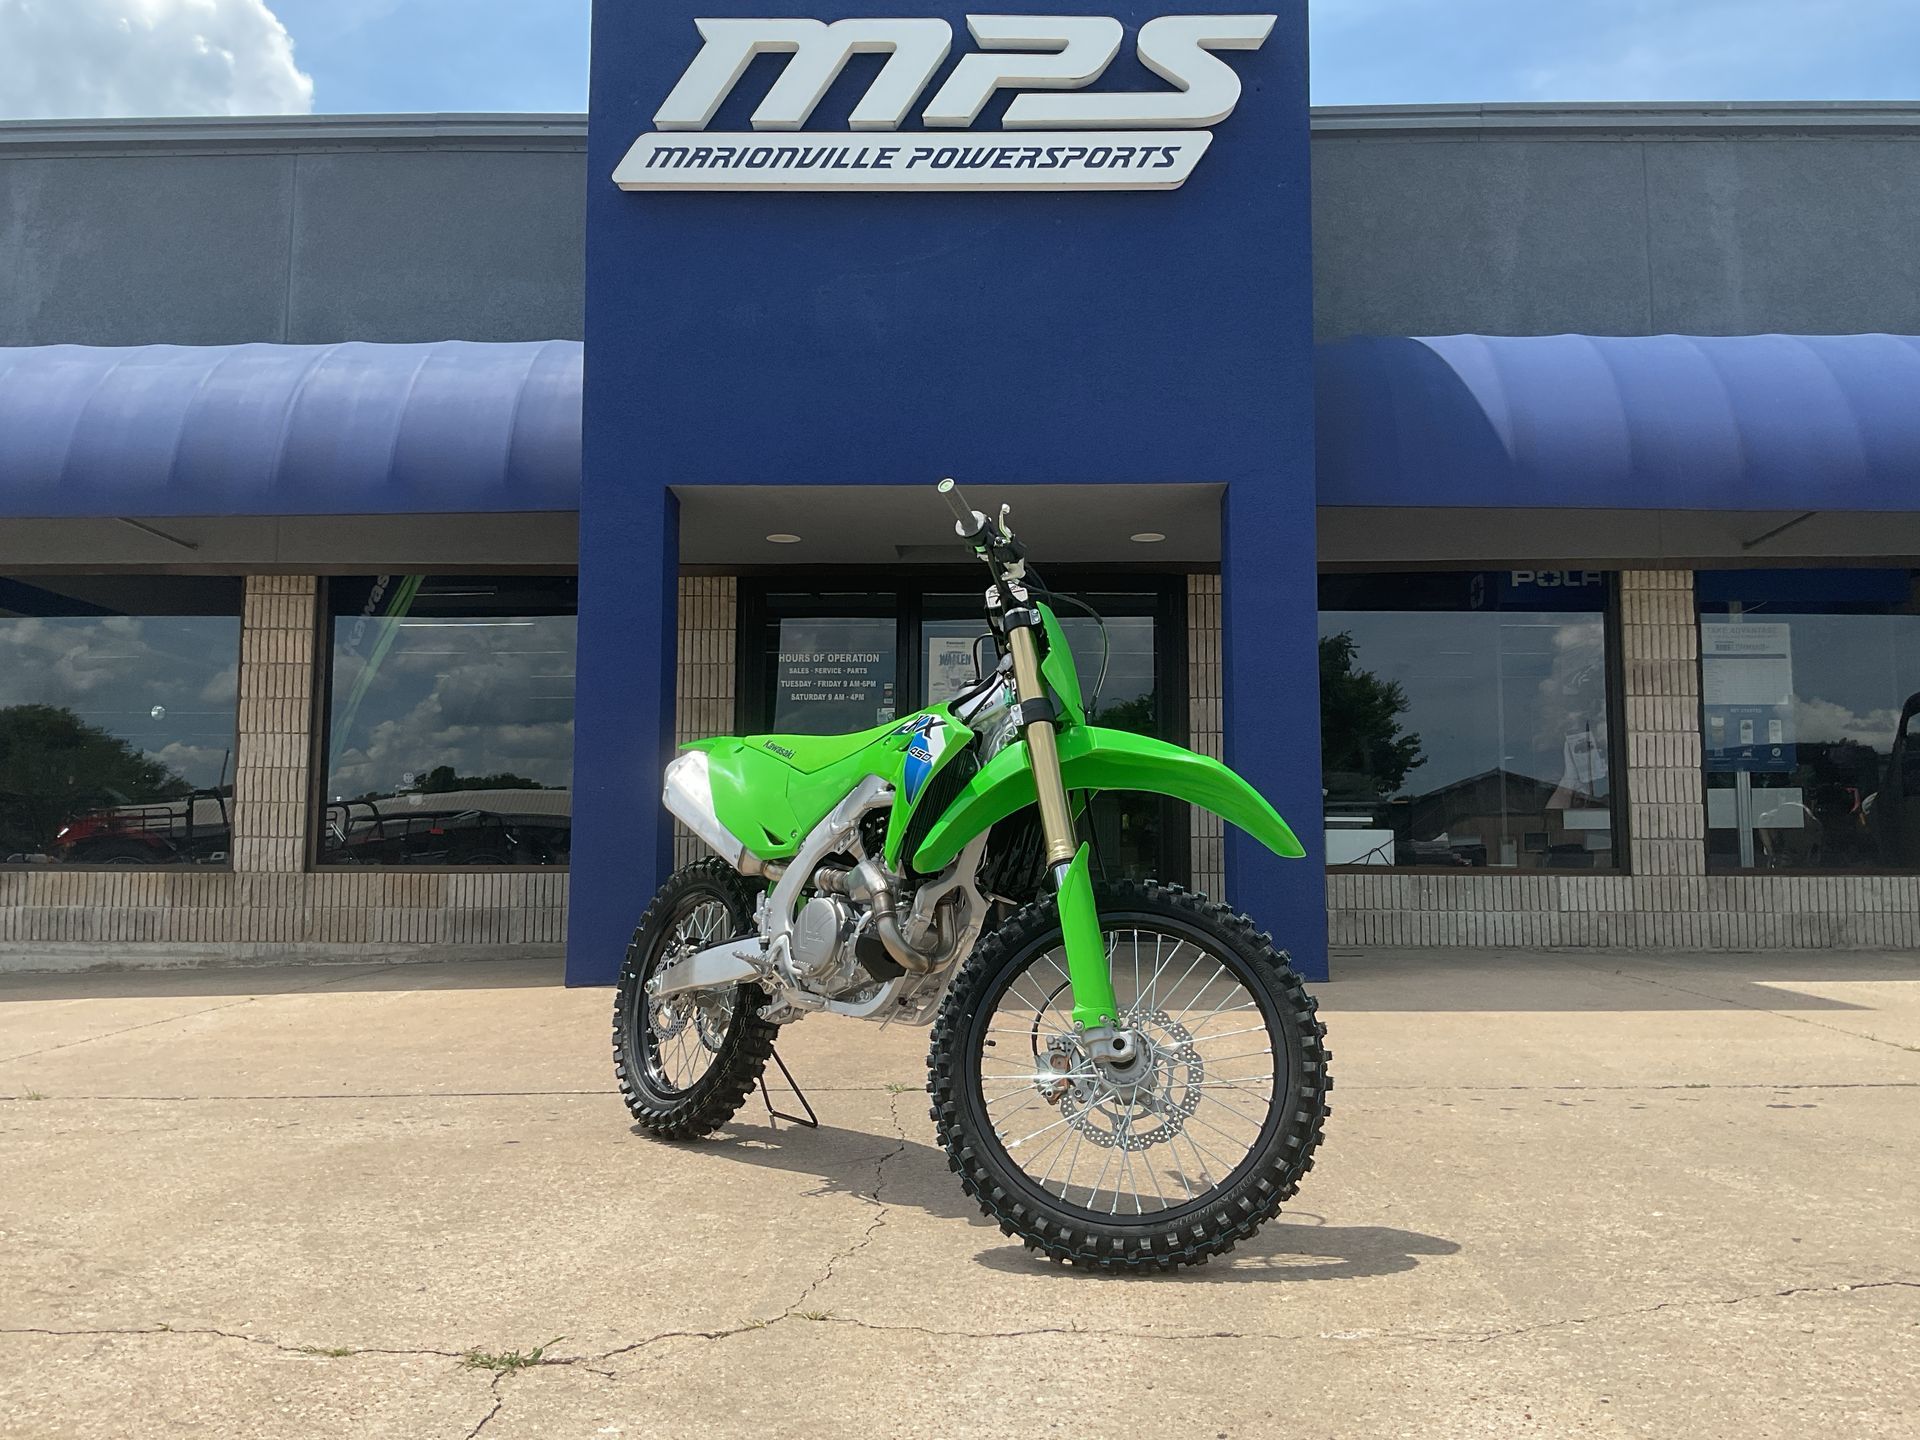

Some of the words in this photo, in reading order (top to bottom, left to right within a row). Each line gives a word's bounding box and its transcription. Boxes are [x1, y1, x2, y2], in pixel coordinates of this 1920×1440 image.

[653, 14, 1277, 130] MPS
[645, 147, 901, 169] MARIONVILLE
[905, 146, 1182, 169] POWERSPORTS
[778, 653, 810, 663] HOURS
[813, 653, 825, 663] OF
[828, 653, 880, 663] OPERATION
[780, 680, 812, 688] TUESDAY
[817, 680, 842, 688] FRIDAY
[843, 680, 848, 688] 9
[791, 693, 827, 701] SATURDAY
[827, 693, 832, 701] 9
[833, 693, 845, 701] AM
[850, 693, 865, 701] 4PM
[903, 714, 949, 740] KX
[762, 739, 797, 760] Kawasaki
[909, 746, 933, 762] 450
